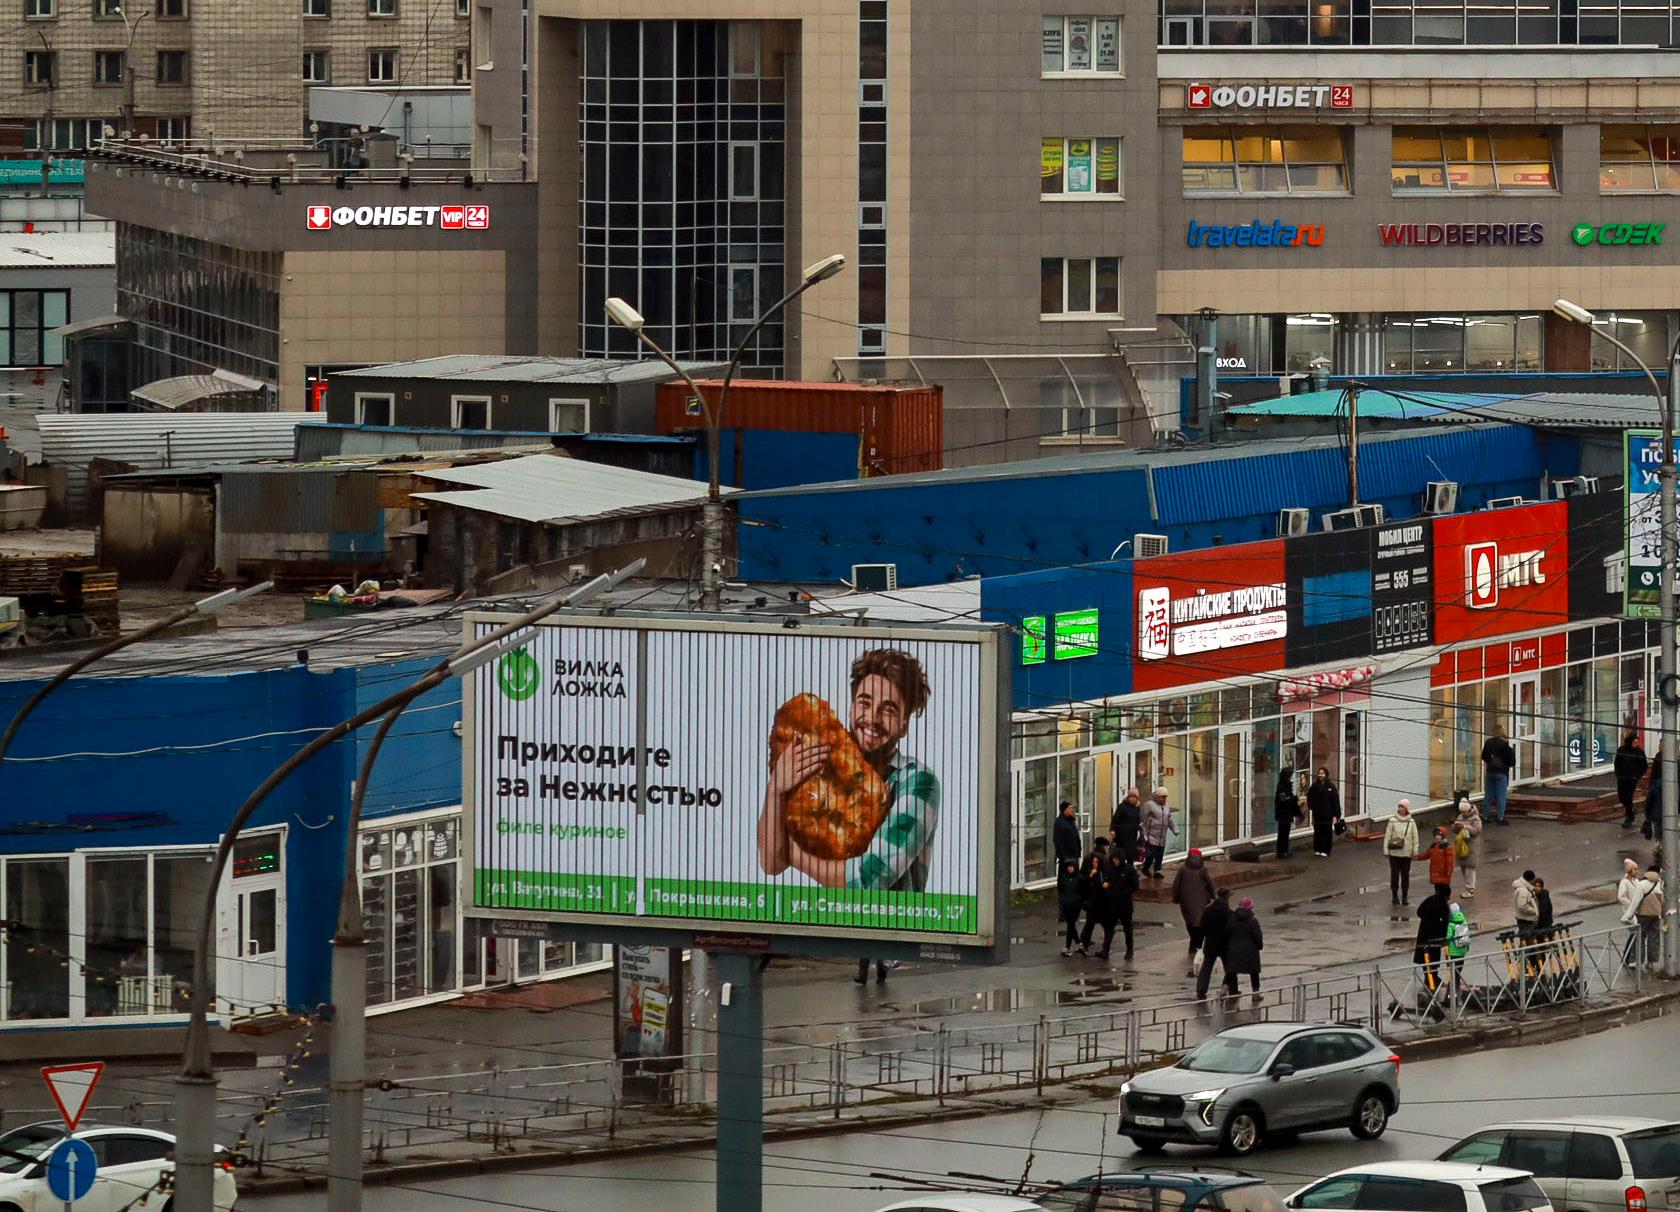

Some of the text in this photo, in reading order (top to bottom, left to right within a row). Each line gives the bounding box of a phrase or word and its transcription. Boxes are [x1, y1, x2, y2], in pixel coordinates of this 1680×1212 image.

[1212, 86, 1350, 107] ФОНБЕТ 24
[332, 206, 486, 226] ФОНБЕТ VIP 24
[1187, 219, 1326, 247] travelata.ru
[1379, 223, 1544, 247] WILDBERRIES
[1216, 358, 1246, 368] ВХОД
[1393, 570, 1409, 589] 555
[1499, 550, 1546, 589] МТС
[1174, 583, 1286, 623] КИТАЙСКИЕ ПРОДУКТЫ
[1145, 598, 1168, 649] 福
[1522, 648, 1536, 659] МТС
[555, 659, 624, 677] ВИЛКА
[552, 680, 627, 699] ЛОЖКА
[497, 735, 671, 769] Приходите
[496, 774, 722, 808] за Нежностью
[496, 818, 627, 840] филе куриное
[486, 881, 508, 896] ул.
[650, 888, 752, 909] Покрышкина,
[791, 900, 813, 914] ул.
[816, 898, 941, 921] Станиславского,
